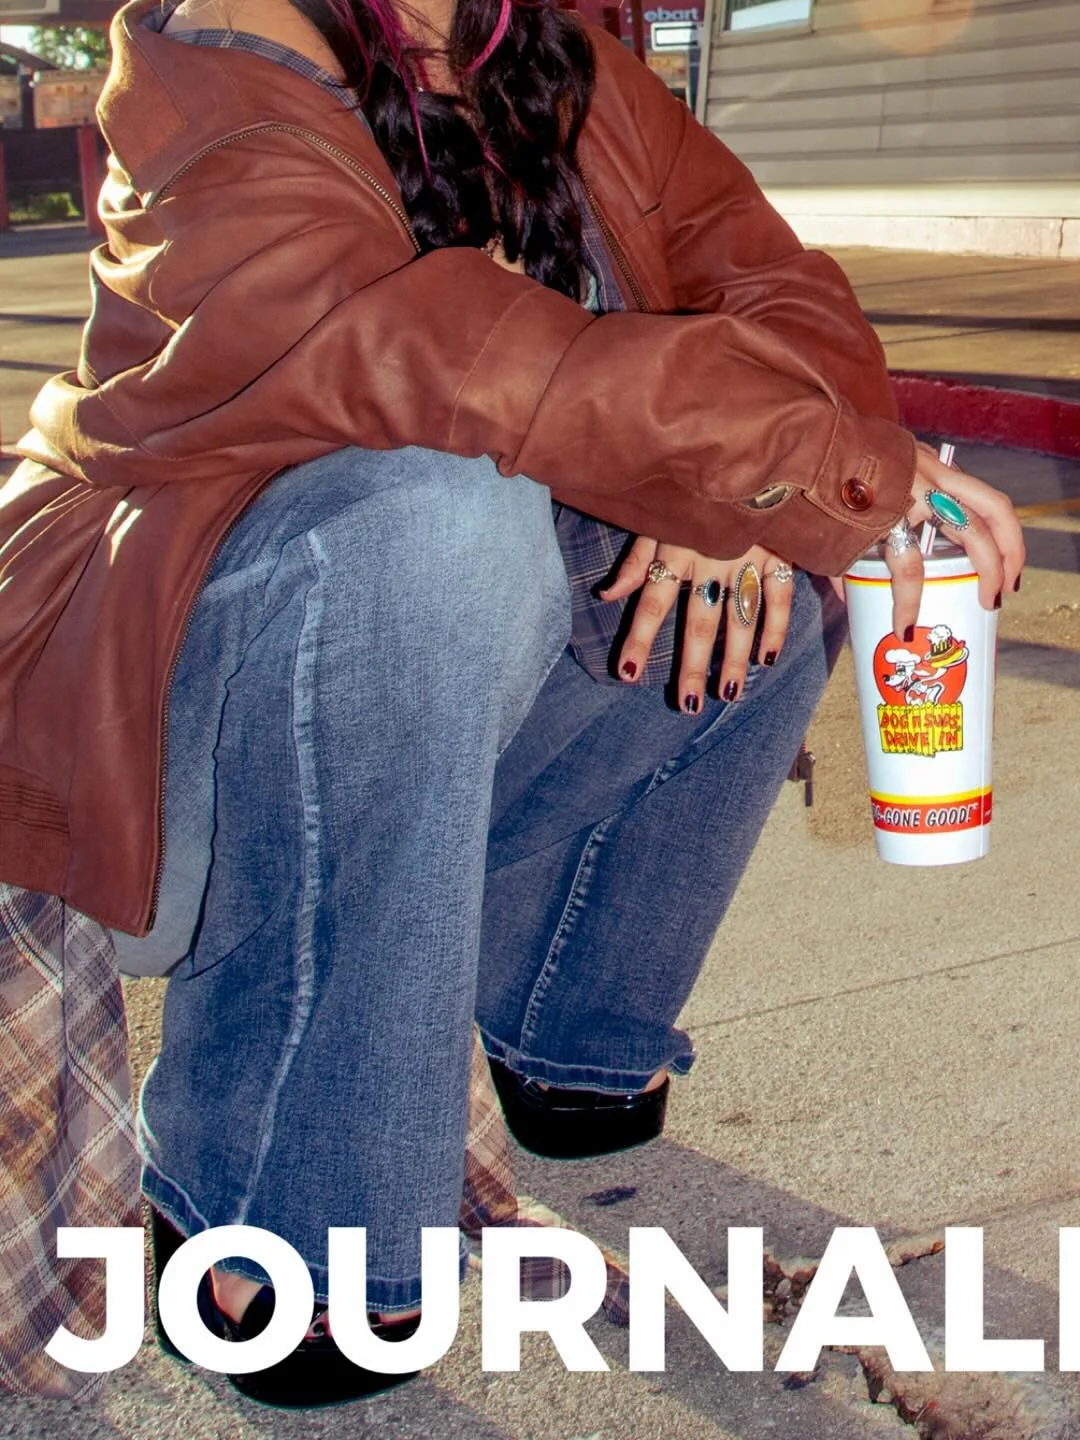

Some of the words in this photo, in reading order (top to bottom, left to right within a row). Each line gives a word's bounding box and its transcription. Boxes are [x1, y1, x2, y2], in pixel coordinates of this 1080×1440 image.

[880, 711, 908, 729] DOG
[922, 711, 961, 728] SUDS
[884, 731, 930, 747] DRIVE
[938, 731, 959, 746] IN
